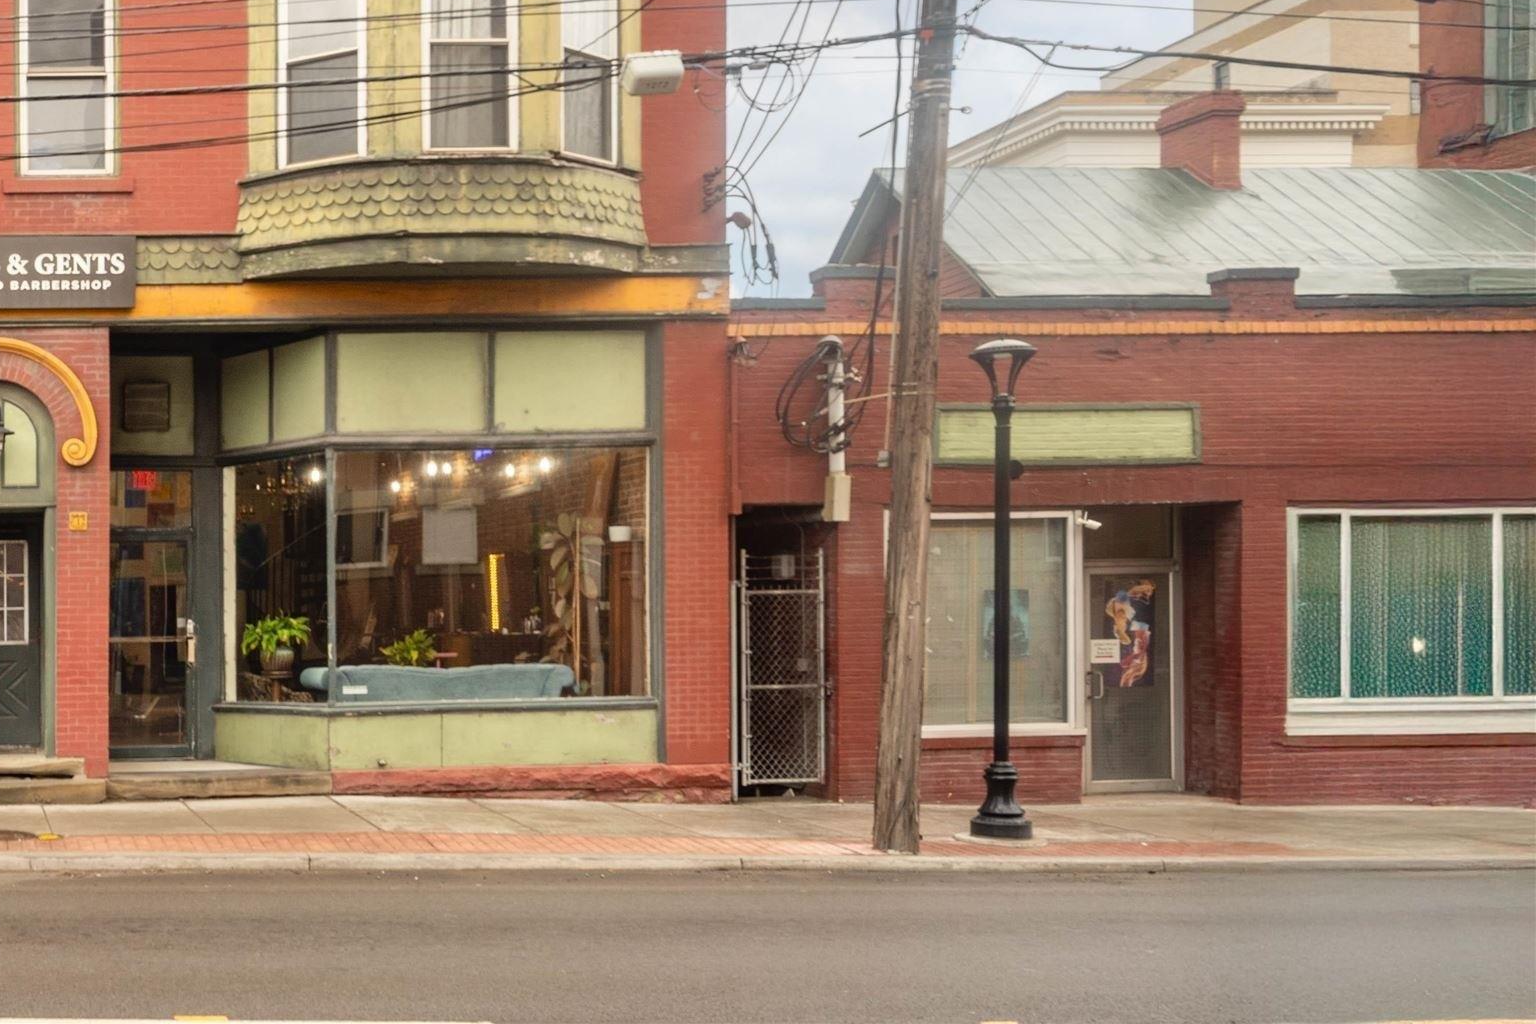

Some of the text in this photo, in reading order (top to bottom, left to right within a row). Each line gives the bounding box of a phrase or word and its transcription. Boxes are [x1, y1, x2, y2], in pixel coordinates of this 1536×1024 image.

[6, 254, 28, 275] &
[34, 253, 125, 275] GENTS
[10, 280, 112, 291] BARBERSHOP
